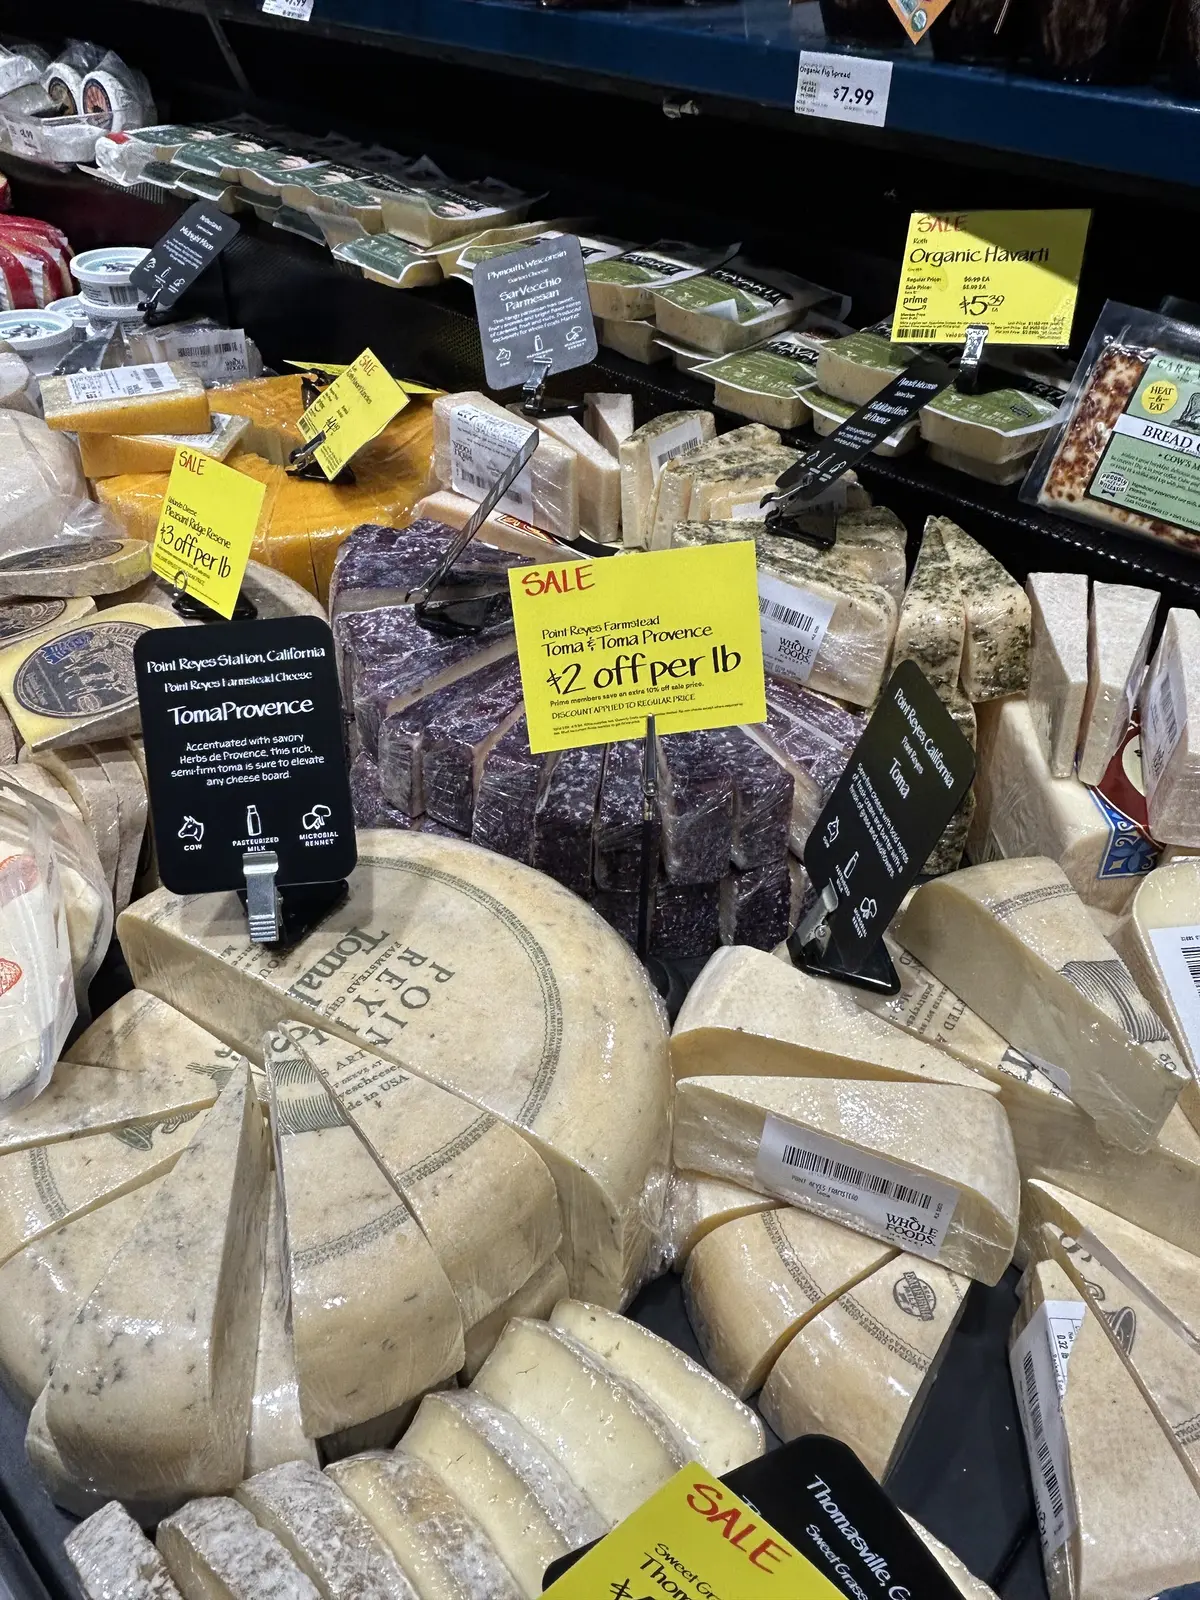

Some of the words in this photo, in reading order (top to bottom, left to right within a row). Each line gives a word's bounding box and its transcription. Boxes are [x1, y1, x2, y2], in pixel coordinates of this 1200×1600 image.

[834, 86, 875, 106] $7.99
[917, 215, 968, 233] SALE
[910, 248, 982, 268] Organic
[985, 246, 1049, 264] Havarti
[500, 277, 562, 301] SarVecchio
[505, 289, 560, 312] Parmesan
[903, 295, 928, 305] prime
[358, 354, 380, 377] SALE
[1151, 386, 1175, 395] HEAT
[1149, 401, 1166, 411] EAT
[1142, 425, 1194, 449] BREAD
[178, 450, 207, 476] SALE
[1164, 453, 1192, 469] COW'S
[1101, 473, 1128, 486] PROUDLY
[165, 504, 189, 528] Pleasant
[188, 517, 207, 538] Ridge
[205, 527, 232, 550] Reserve
[159, 522, 175, 546] $3
[174, 532, 198, 558] off
[194, 547, 219, 571] per
[218, 555, 232, 579] lb
[521, 564, 596, 596] SALE
[541, 628, 568, 640] Point
[568, 624, 603, 637] Reyes
[603, 615, 661, 632] Farmstead
[541, 640, 585, 657] Toma
[586, 637, 597, 652] &
[597, 633, 639, 650] Toma
[643, 626, 714, 645] Provence
[779, 636, 814, 657] WHOLE
[147, 659, 177, 674] Point
[178, 656, 218, 672] Reyes
[217, 651, 267, 668] Station,
[266, 646, 326, 664] California
[777, 644, 812, 665] FOODS
[164, 681, 189, 694] Point
[189, 678, 222, 692] Reyes
[221, 672, 275, 688] Farmstead
[275, 669, 313, 684] Cheese
[546, 662, 587, 695] $2
[593, 652, 648, 689] off
[649, 655, 707, 687] per
[711, 644, 742, 674] lb
[550, 699, 570, 708] Prime
[570, 694, 602, 705] members
[602, 693, 618, 702] save
[628, 688, 645, 697] extra
[645, 683, 660, 694] 10%
[660, 682, 670, 691] off
[671, 682, 685, 690] sale
[685, 679, 705, 692] price.
[167, 698, 316, 727] TomaProvence
[550, 706, 593, 720] DISCOUNT
[593, 700, 626, 715] APPLIED
[625, 698, 637, 710] TO
[636, 695, 673, 708] REGULAR
[671, 692, 696, 704] PRICE
[185, 736, 248, 753] Accentuated
[247, 734, 271, 747] with
[271, 733, 304, 747] savory
[894, 686, 912, 716] Point
[906, 707, 927, 745] Reyes,
[923, 737, 956, 789] California
[170, 764, 217, 779] semi-firm
[216, 760, 243, 774] toma
[244, 762, 254, 773] is
[254, 758, 278, 771] sure
[277, 756, 290, 769] to
[289, 754, 326, 768] elevate
[179, 753, 208, 766] Herbs
[208, 752, 222, 762] de
[222, 748, 270, 763] Provence,
[269, 744, 291, 757] this
[291, 743, 314, 756] rich,
[901, 735, 917, 757] Point
[910, 751, 925, 776] Reyes
[206, 775, 225, 788] any
[225, 772, 261, 786] cheese
[260, 769, 292, 783] board.
[888, 757, 912, 799] Toma
[848, 782, 861, 803] finish
[859, 809, 873, 830] grass
[873, 838, 896, 880] wildflowers.
[857, 779, 869, 798] fresh
[864, 796, 878, 818] cream
[879, 828, 893, 852] butter
[889, 850, 902, 868] with
[870, 790, 886, 815] cheese
[881, 813, 894, 831] with
[888, 827, 901, 844] bold
[895, 841, 910, 865] notes
[183, 843, 203, 852] COW
[232, 836, 280, 848] PASTEURIZED
[246, 844, 267, 853] MILK
[298, 832, 340, 842] MICROBIAL
[304, 839, 335, 848] RENNET
[346, 941, 403, 995] FARMSTEAD
[362, 961, 456, 1047] POIN
[362, 1091, 380, 1102] in
[379, 1074, 410, 1092] USA
[884, 1224, 937, 1248] FOODS
[885, 1211, 939, 1237] WHOLE
[844, 1298, 866, 1318] TOMA
[858, 1319, 888, 1346] CHEESE
[866, 1319, 890, 1340] TOMA
[893, 1341, 918, 1360] TOMA
[1056, 1334, 1069, 1350] 0.32
[1060, 1352, 1070, 1360] lb
[686, 1483, 794, 1576] SALE
[805, 1473, 893, 1588] Thomasville,
[654, 1542, 699, 1588] Sweet
[805, 1523, 844, 1574] Sweet
[835, 1562, 872, 1600] Grass
